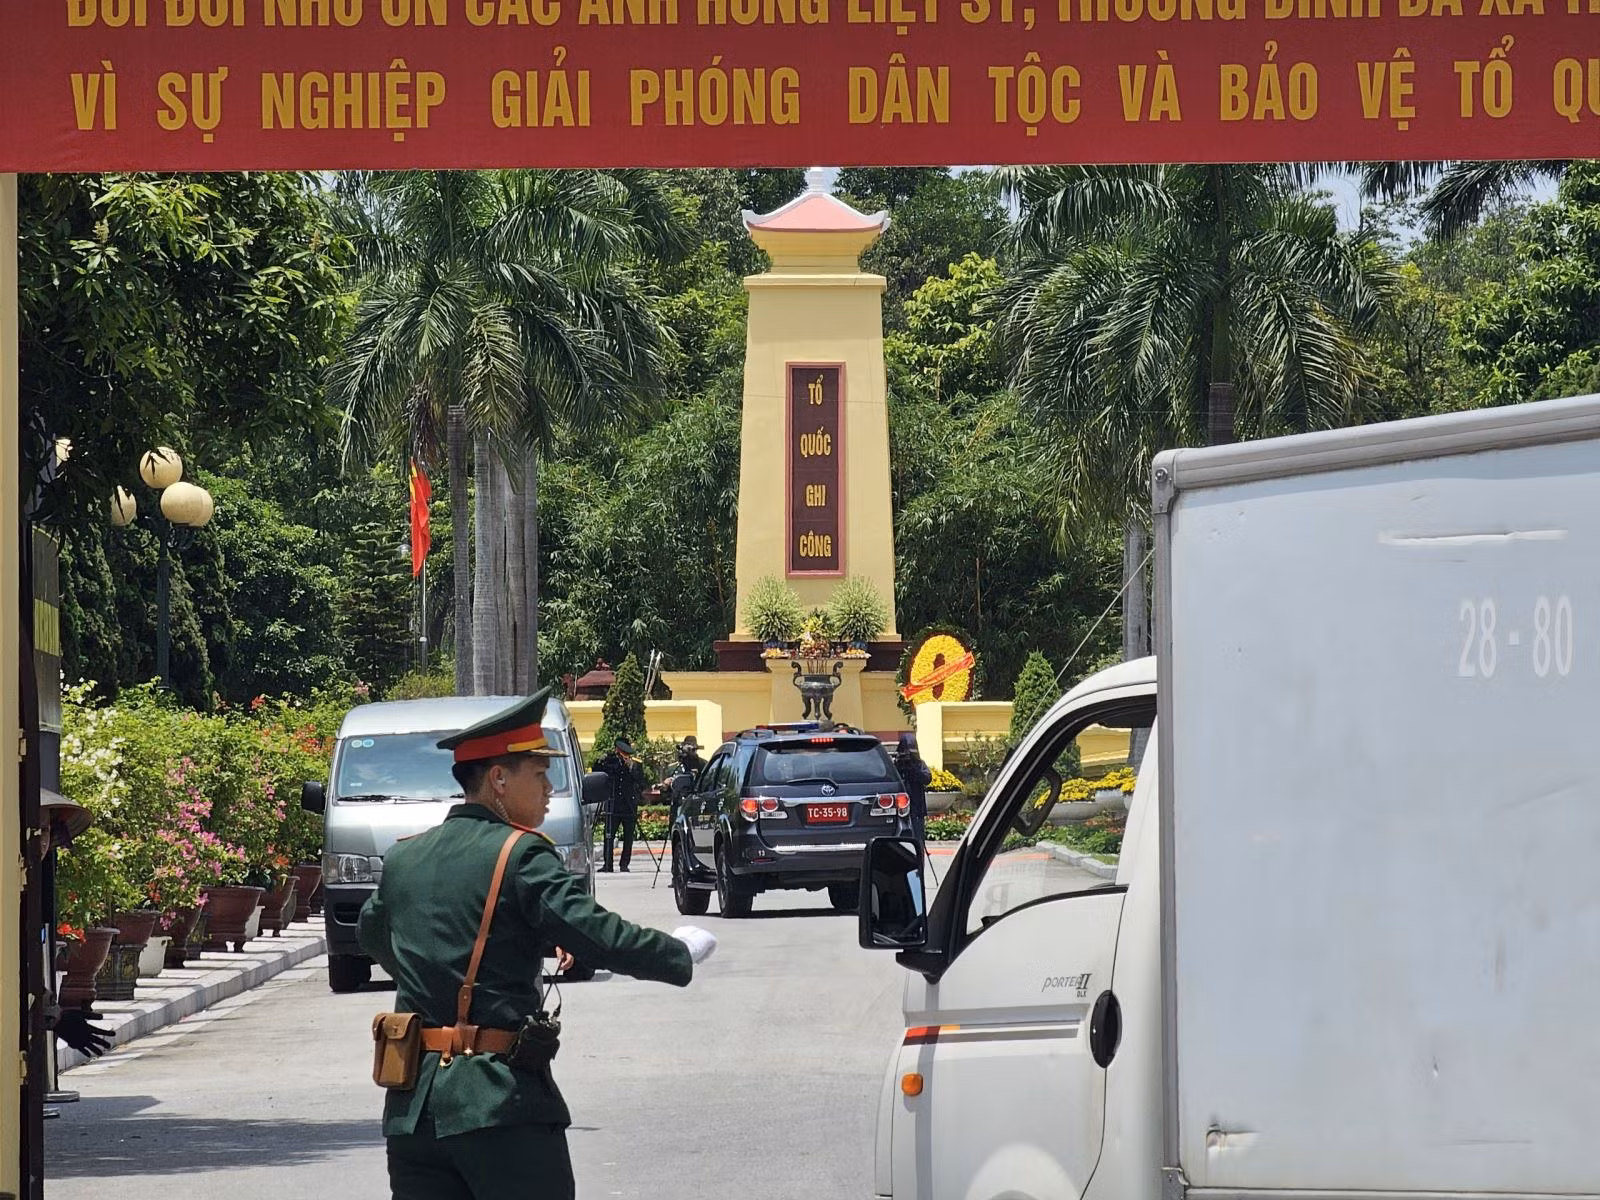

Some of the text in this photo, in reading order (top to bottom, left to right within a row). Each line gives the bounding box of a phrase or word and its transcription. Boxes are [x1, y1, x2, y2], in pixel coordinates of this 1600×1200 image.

[70, 60, 117, 131] VÌ
[156, 66, 229, 143] SỰ
[261, 58, 446, 142] NGHIỆP
[491, 46, 591, 129] GIẢI
[630, 55, 800, 126] PHÓNG
[848, 52, 950, 124] DÂN
[988, 51, 1081, 137] TỘC
[1118, 49, 1182, 122] VÀ
[1220, 40, 1318, 121] BẢO
[1357, 47, 1416, 131] VỆ
[1453, 34, 1515, 118] TỔ
[808, 375, 824, 405] TỔ
[800, 426, 831, 458] QUỐC
[806, 484, 826, 507] GHI
[799, 530, 832, 557] CÔNG
[808, 807, 847, 818] TC-35-98
